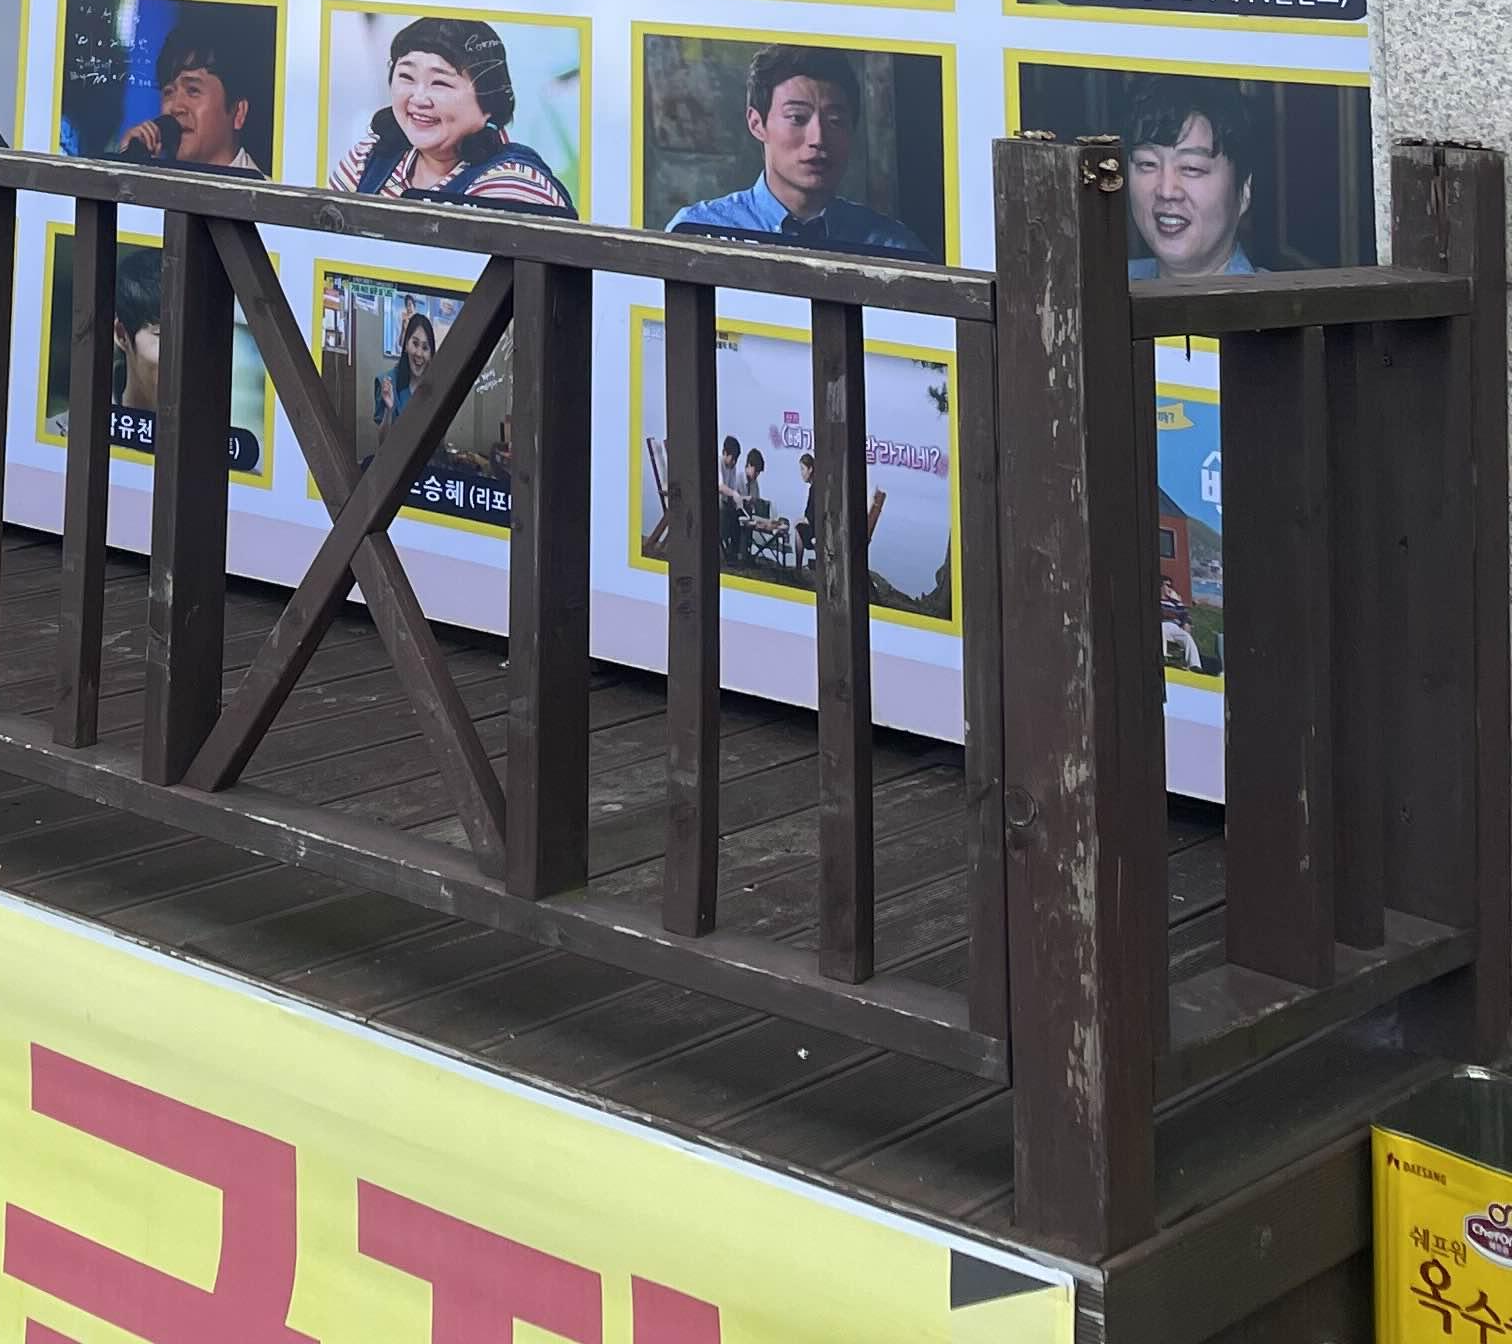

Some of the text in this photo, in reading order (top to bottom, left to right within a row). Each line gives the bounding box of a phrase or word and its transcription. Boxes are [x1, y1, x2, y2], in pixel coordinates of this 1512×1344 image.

[469, 487, 512, 512] (리포
[1409, 1225, 1468, 1268] 쉐프원
[1410, 1257, 1512, 1344] 옥수
